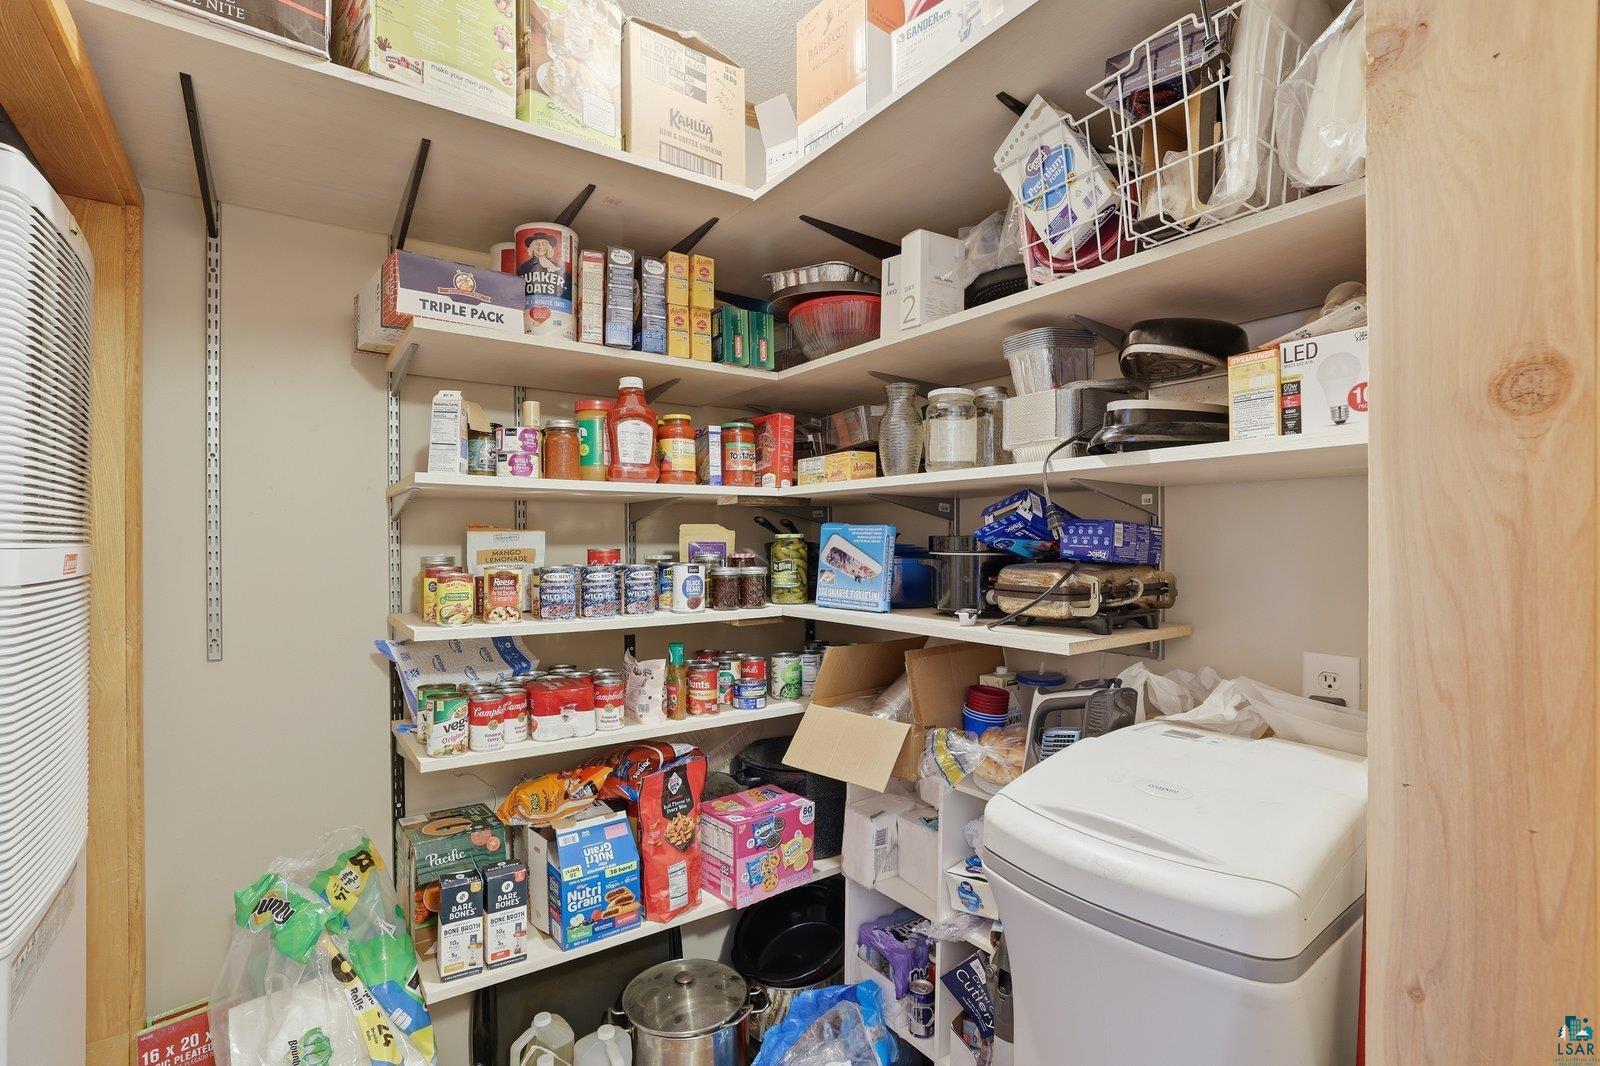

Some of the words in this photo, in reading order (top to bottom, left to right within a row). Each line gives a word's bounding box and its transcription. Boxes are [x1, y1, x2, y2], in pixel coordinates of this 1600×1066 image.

[906, 12, 939, 39] GANDER
[808, 22, 848, 61] BAREFOOT
[526, 284, 555, 294] OATS
[904, 284, 915, 293] DAY
[419, 298, 466, 318] TRIPLE
[471, 308, 504, 324] PACK
[903, 294, 916, 325] 2
[1231, 350, 1275, 365] SYLVANIA
[1283, 342, 1318, 364] LED
[1087, 549, 1110, 559] Ziploc
[493, 578, 514, 586] Reese
[481, 647, 494, 663] prime
[434, 655, 447, 673] prime
[466, 665, 480, 681] prime
[803, 806, 813, 814] 60
[755, 824, 774, 837] OREO
[583, 842, 612, 857] Grain
[784, 842, 801, 856] OREO
[425, 848, 467, 868] Pacific
[585, 850, 614, 868] Nutri
[497, 892, 517, 902] BARE
[567, 881, 602, 903] Nutri
[451, 902, 472, 912] BARE
[495, 898, 520, 909] BONES
[567, 894, 602, 912] Grain
[449, 909, 475, 920] BONES
[490, 915, 505, 924] BONE
[506, 911, 525, 921] BROTH
[444, 927, 459, 936] BONE
[461, 923, 480, 933] BROTH
[351, 986, 364, 1011] Rolls
[956, 969, 995, 1028] Cutlery
[377, 1024, 394, 1047] 24
[142, 1048, 159, 1066] 16
[166, 1045, 175, 1057] x
[181, 1033, 199, 1051] 20
